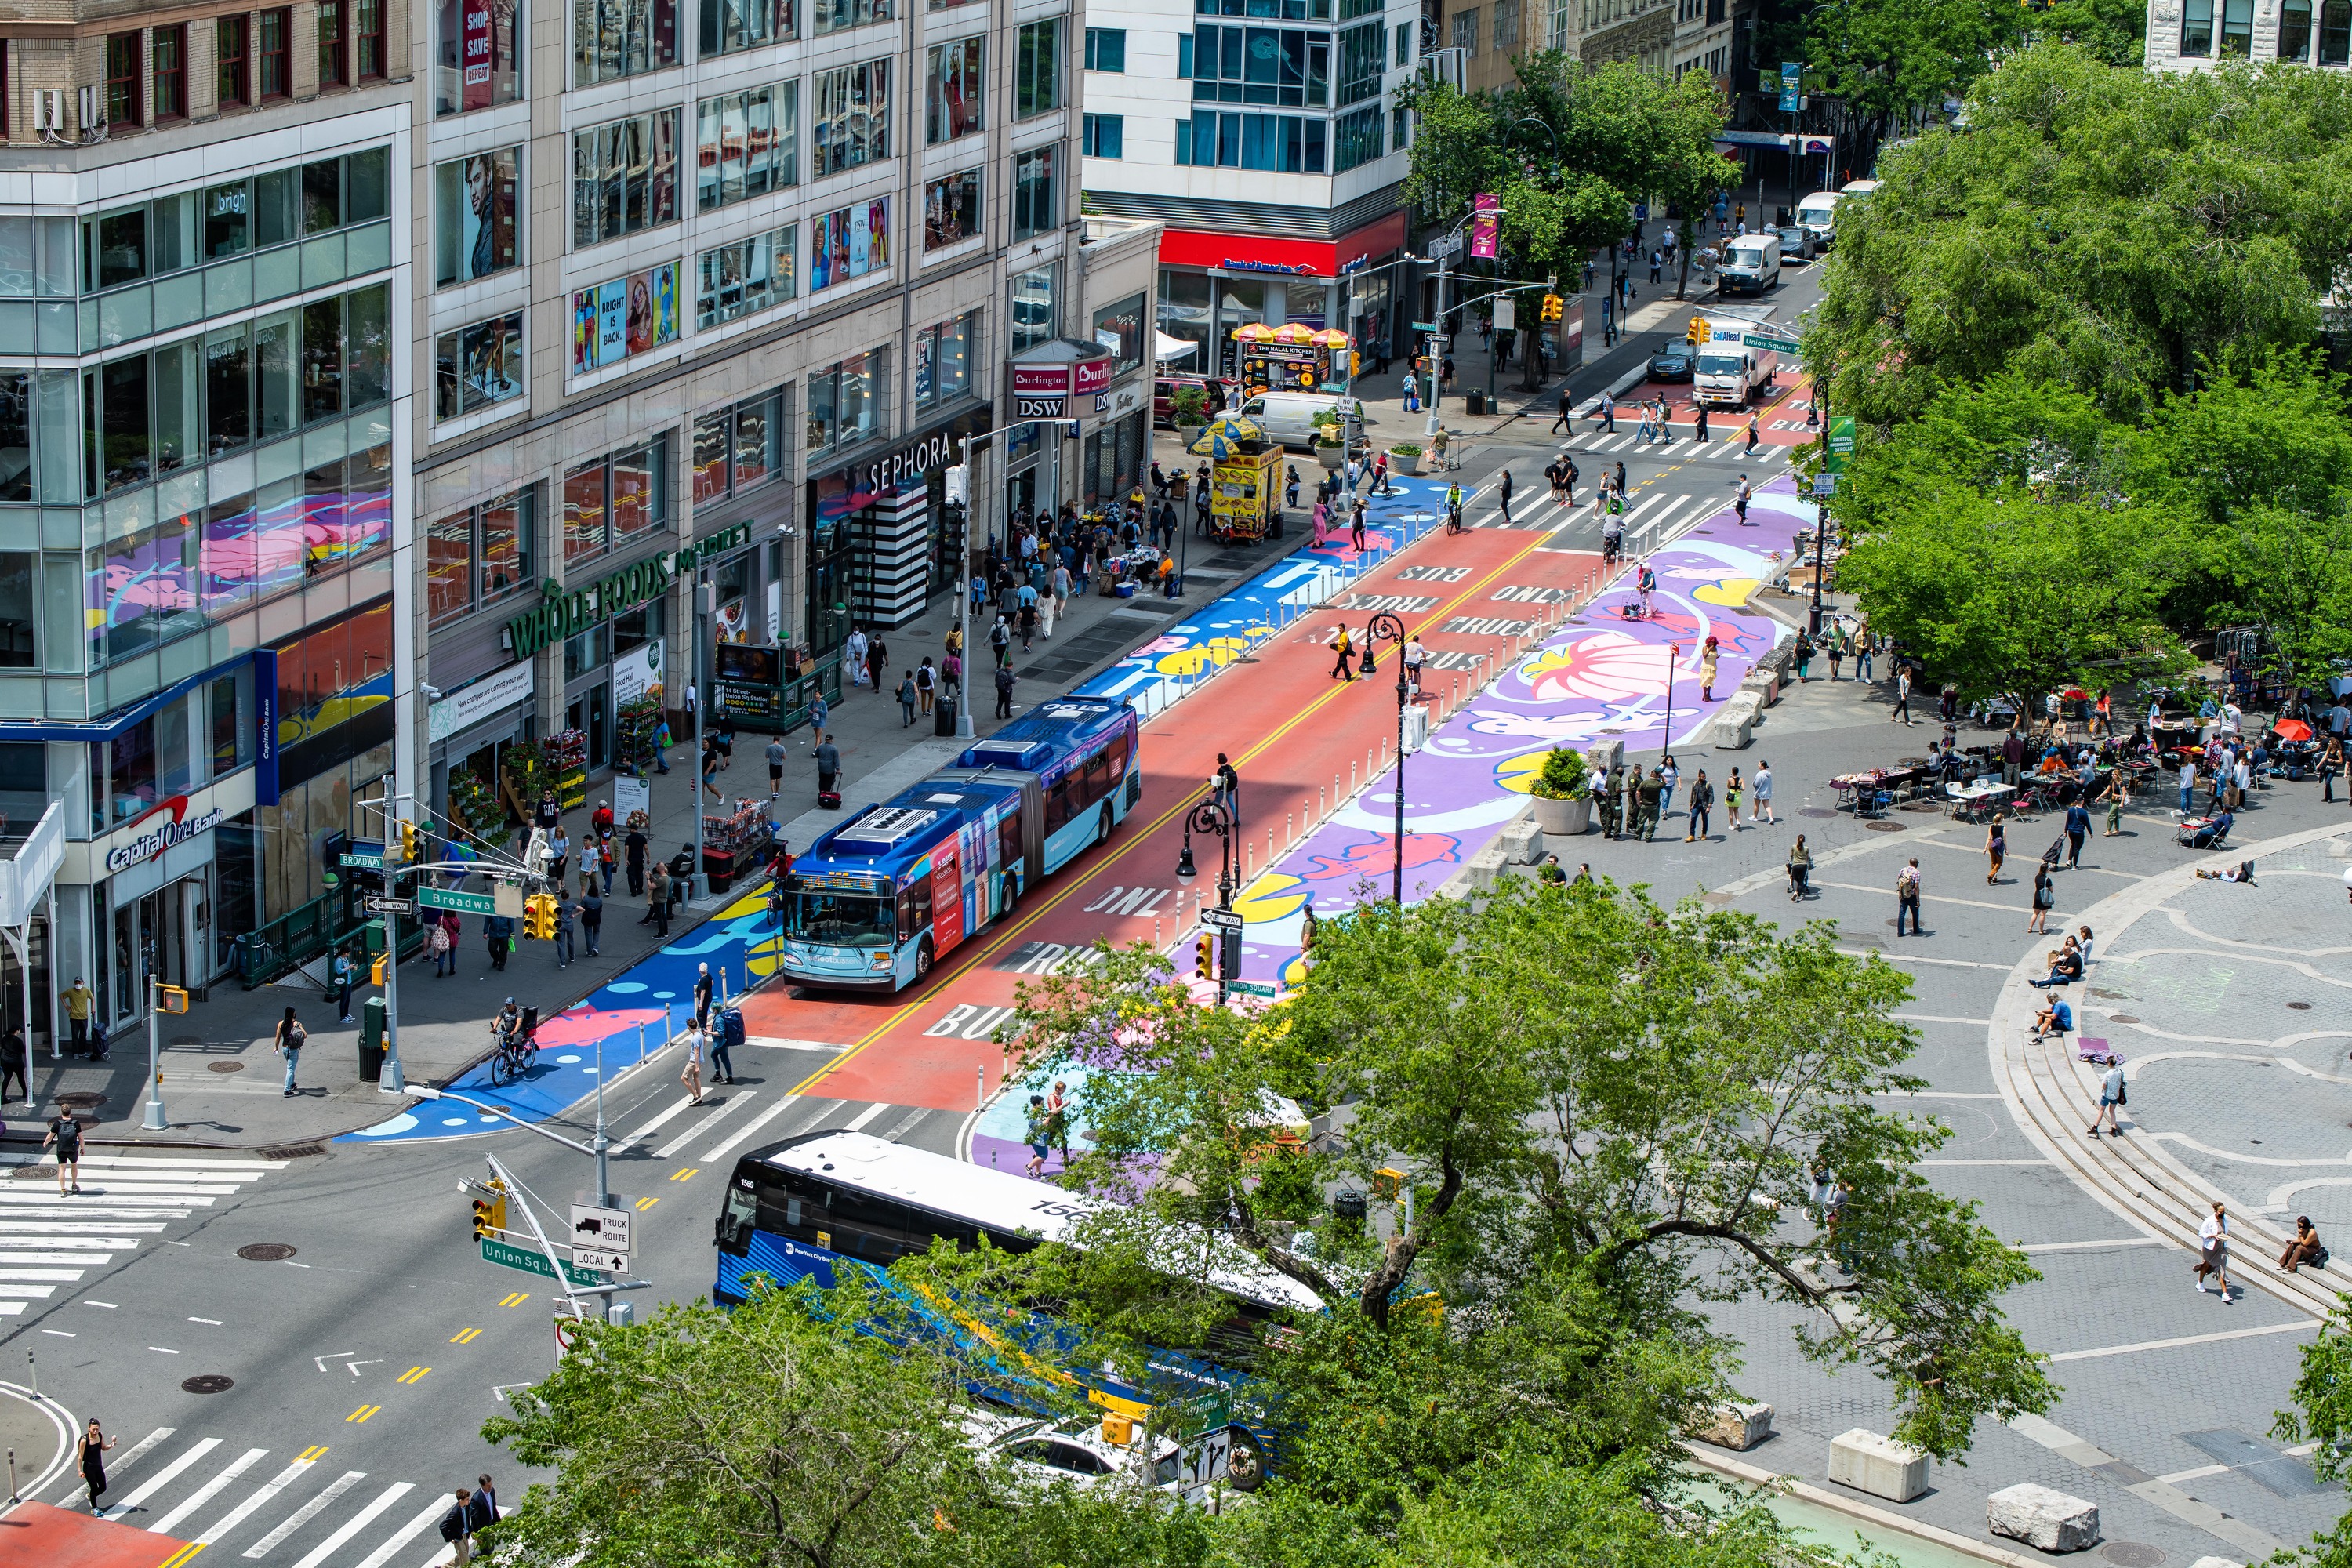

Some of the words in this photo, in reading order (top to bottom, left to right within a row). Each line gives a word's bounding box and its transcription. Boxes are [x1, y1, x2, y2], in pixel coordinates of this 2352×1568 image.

[467, 11, 488, 31] SHOP
[467, 37, 488, 57] SAVE
[468, 67, 488, 81] REPEAT
[855, 220, 865, 231] DSW
[1225, 259, 1247, 269] Bank
[1247, 261, 1257, 270] of
[1256, 262, 1293, 273] America
[602, 296, 625, 314] BRIGHT
[610, 315, 616, 328] IS
[240, 325, 277, 350] cotract
[604, 330, 622, 346] BACK.
[1713, 331, 1740, 342] CallAHead
[1746, 338, 1766, 347] Union
[1767, 340, 1792, 351] Square
[1016, 374, 1067, 387] Burlington
[1078, 364, 1112, 382] Burlin
[1019, 400, 1062, 417] DSW
[869, 432, 950, 495] SEPHORA
[1397, 565, 1474, 583] BUS
[510, 577, 593, 661] WHOLE
[596, 550, 669, 622] FOODS
[675, 519, 755, 578] MARKET
[1490, 585, 1576, 604] ONLY
[1338, 593, 1440, 613] TRUCK
[1446, 615, 1552, 638] TRUCK
[649, 647, 659, 656] WHOLE
[649, 653, 659, 662] FOODS
[615, 675, 626, 688] Food
[626, 672, 634, 683] Hall
[803, 679, 815, 689] Subway
[457, 699, 467, 710] New
[467, 691, 484, 704] changes
[490, 681, 506, 692] coming
[506, 676, 517, 687] your
[517, 670, 527, 681] way!
[464, 707, 475, 716] looking
[474, 702, 485, 710] forward
[194, 808, 224, 836] Bank
[343, 855, 381, 867] BROADWAY
[935, 866, 953, 880] WELLNESS
[433, 893, 495, 910] Broadwa
[1083, 886, 1171, 917] ONL
[1206, 913, 1219, 921] ONE
[1229, 981, 1247, 989] UNION
[1250, 984, 1273, 994] SQUARE
[741, 1178, 754, 1189] 1569
[1030, 1200, 1091, 1222] 156
[603, 1218, 627, 1229] TRUCK
[603, 1232, 626, 1243] ROUTE
[485, 1244, 522, 1265] Union
[524, 1256, 571, 1276] Squae
[578, 1253, 606, 1266] LOCAL
[813, 1253, 822, 1261] City
[1147, 1360, 1171, 1373] Escape
[1197, 1375, 1210, 1384] just
